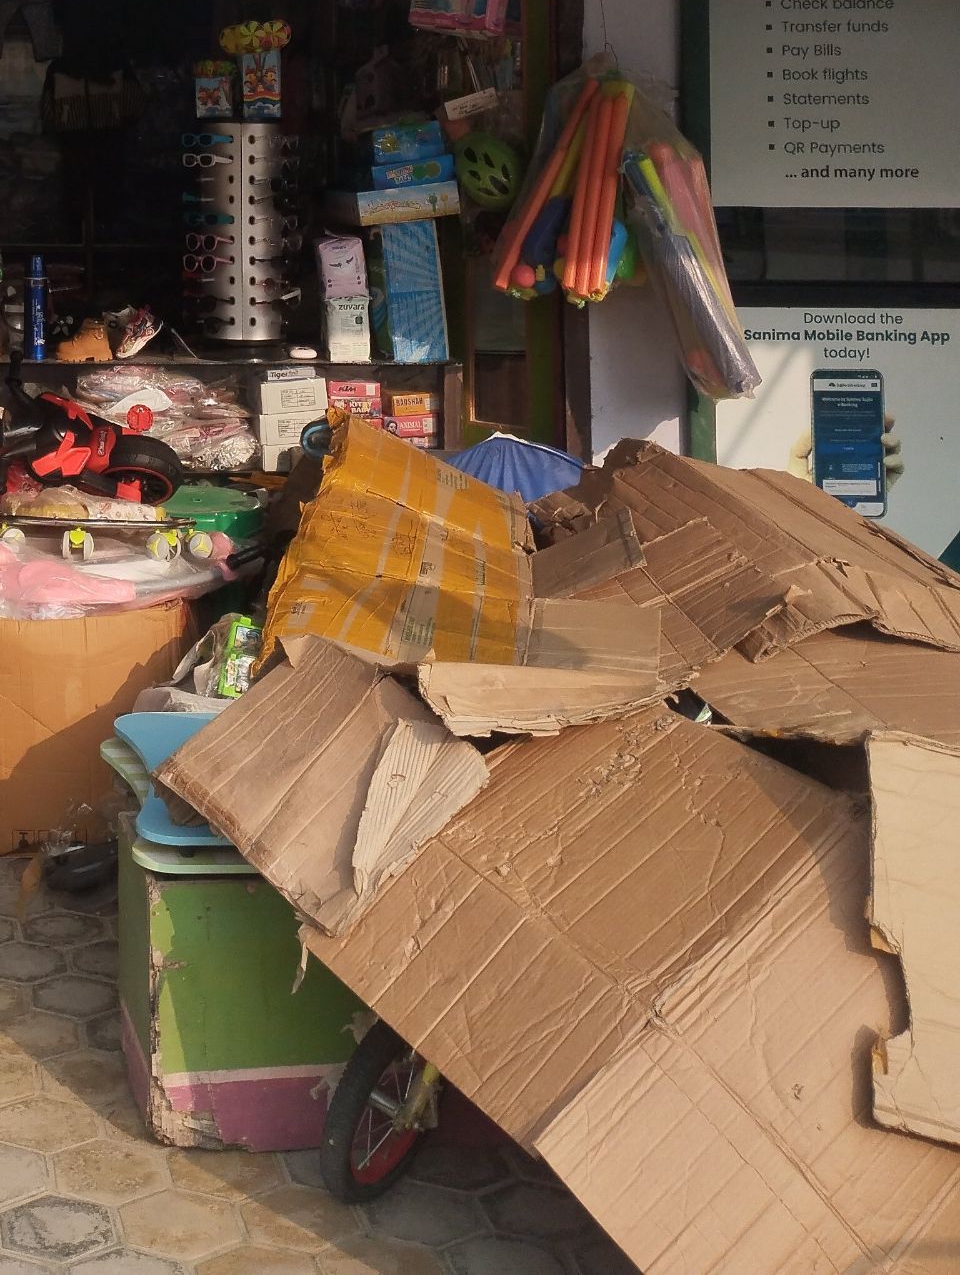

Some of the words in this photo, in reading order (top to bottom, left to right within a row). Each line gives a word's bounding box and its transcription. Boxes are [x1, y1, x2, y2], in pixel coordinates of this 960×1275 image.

[781, 20, 842, 33] Transfer
[847, 20, 889, 33] funds
[781, 44, 810, 60] Pay
[813, 43, 843, 57] Bills
[782, 68, 819, 81] Book
[822, 68, 869, 85] flights
[783, 92, 870, 106] Statements
[783, 117, 841, 133] Top-up
[783, 141, 805, 155] QR
[809, 141, 886, 158] Payments
[800, 165, 831, 179] and
[833, 167, 876, 182] many
[879, 167, 920, 180] more
[803, 312, 876, 325] Download
[879, 312, 904, 325] the
[743, 329, 801, 342] Sanima
[803, 328, 853, 342] Mobile
[856, 329, 917, 345] Banking
[920, 330, 951, 344] App
[823, 346, 870, 362] today!
